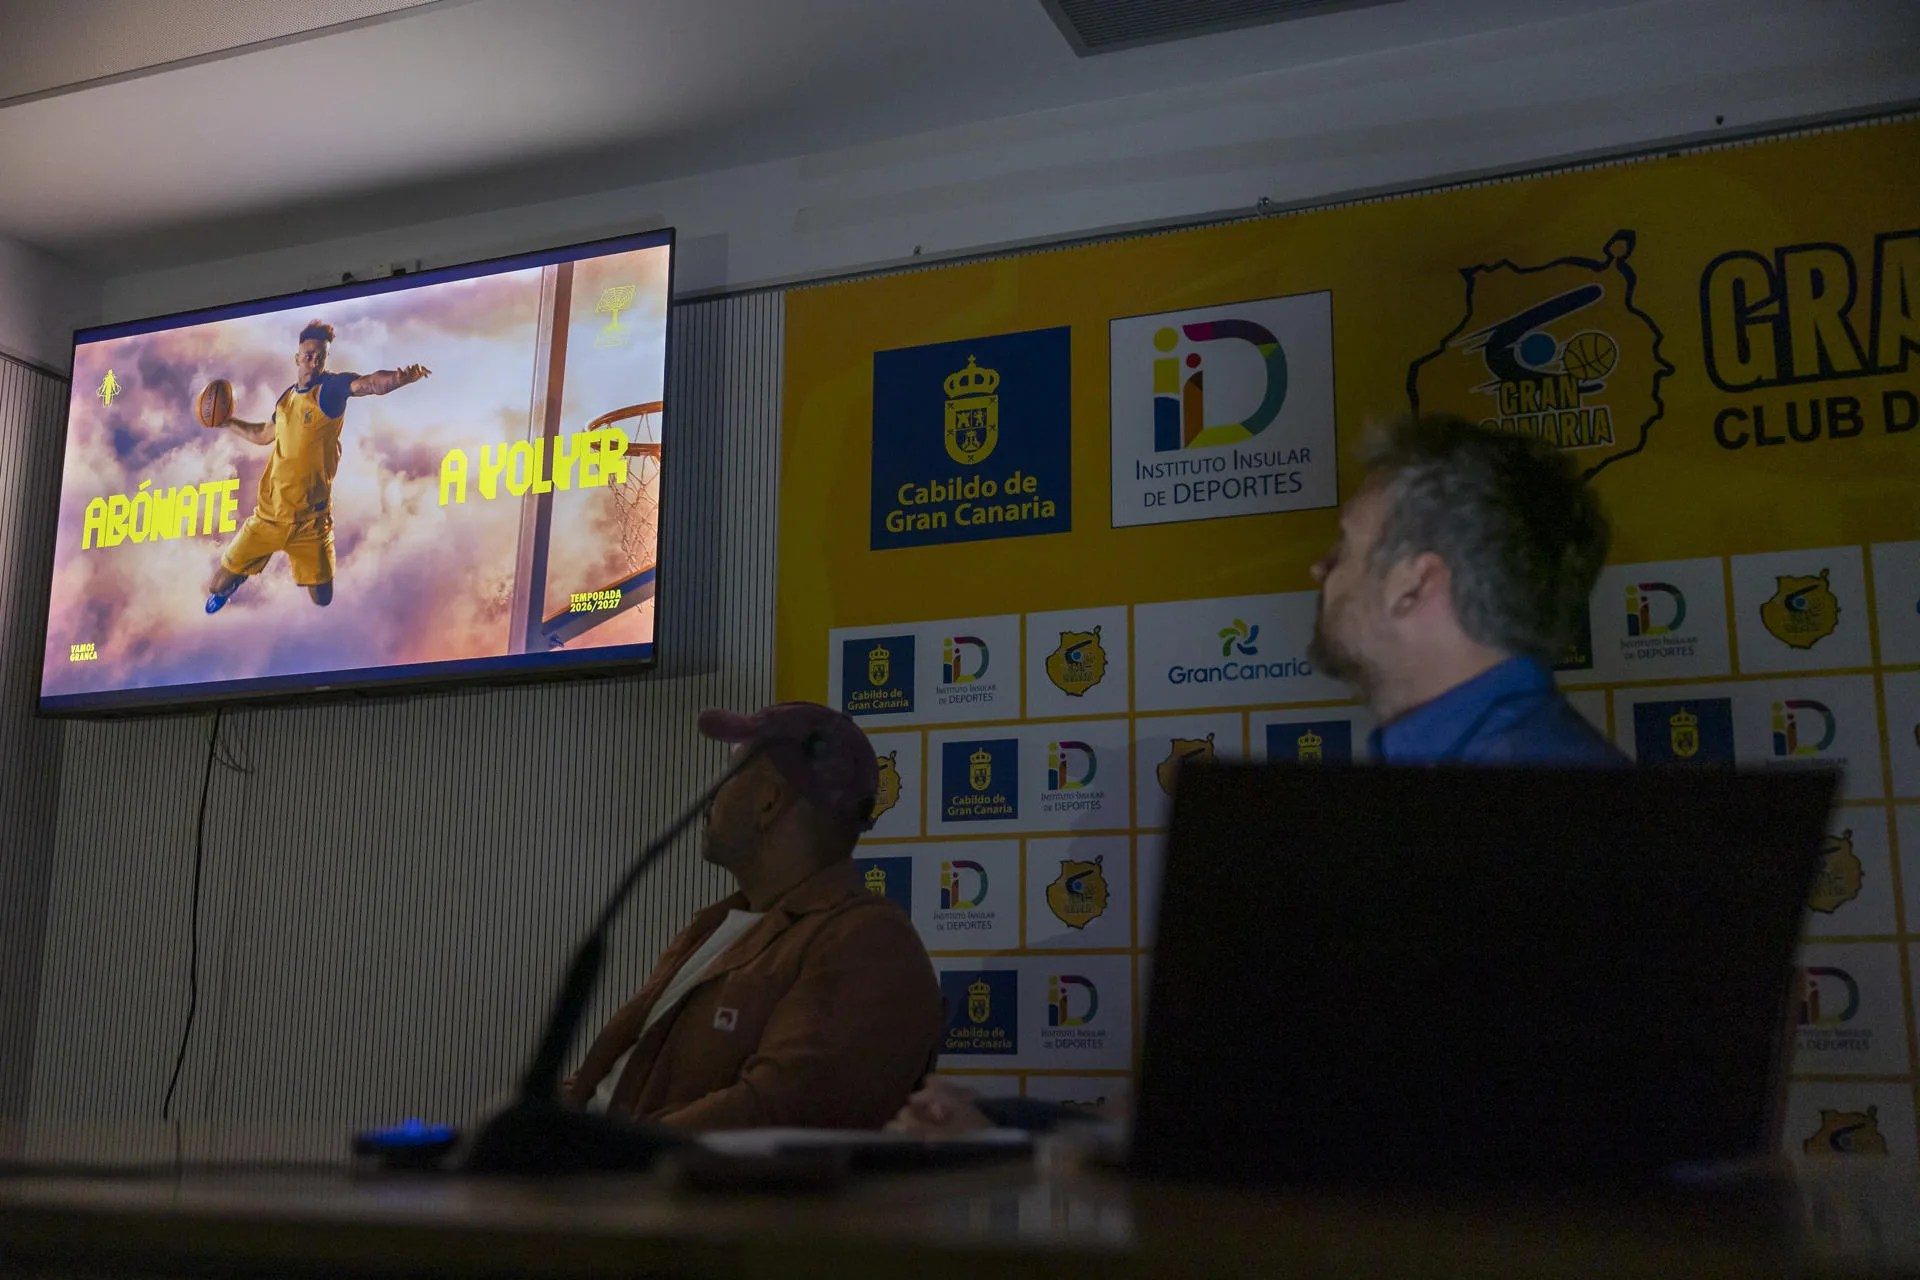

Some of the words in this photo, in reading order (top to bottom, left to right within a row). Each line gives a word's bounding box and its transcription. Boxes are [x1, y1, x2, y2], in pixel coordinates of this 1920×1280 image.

[1500, 375, 1580, 415] GRAN
[1714, 396, 1864, 449] CLUB
[1136, 460, 1226, 481] INSTITUTO
[1234, 447, 1311, 470] INSULAR
[438, 448, 468, 506] A
[897, 475, 998, 506] Cabildo
[1004, 470, 1038, 495] de
[1144, 491, 1167, 507] DE
[1174, 471, 1303, 505] DEPORTES
[82, 479, 240, 550] ABÓNATE
[885, 510, 948, 533] Gran
[954, 496, 1056, 526] Canaria
[570, 589, 622, 603] TEMPORADA
[570, 599, 621, 613] 2026/2027
[71, 643, 95, 654] VAMOS
[1168, 657, 1313, 685] GranCanaria
[851, 688, 889, 701] Cabildo
[891, 688, 903, 698] de
[949, 693, 993, 704] DEPORTES
[847, 701, 872, 711] Gran
[873, 699, 909, 709] Canaria
[951, 795, 990, 805] Cabildo
[992, 793, 1006, 803] de
[1054, 800, 1103, 811] DEPORTES
[947, 805, 972, 816] Gran
[974, 804, 1013, 815] Canaria
[946, 921, 992, 930] DEPORTES
[950, 1027, 989, 1038] Cabildo
[991, 1027, 1005, 1037] de
[945, 1038, 971, 1048] Gran
[972, 1037, 1012, 1048] Canaria
[1055, 1038, 1103, 1048] DEPORTES
